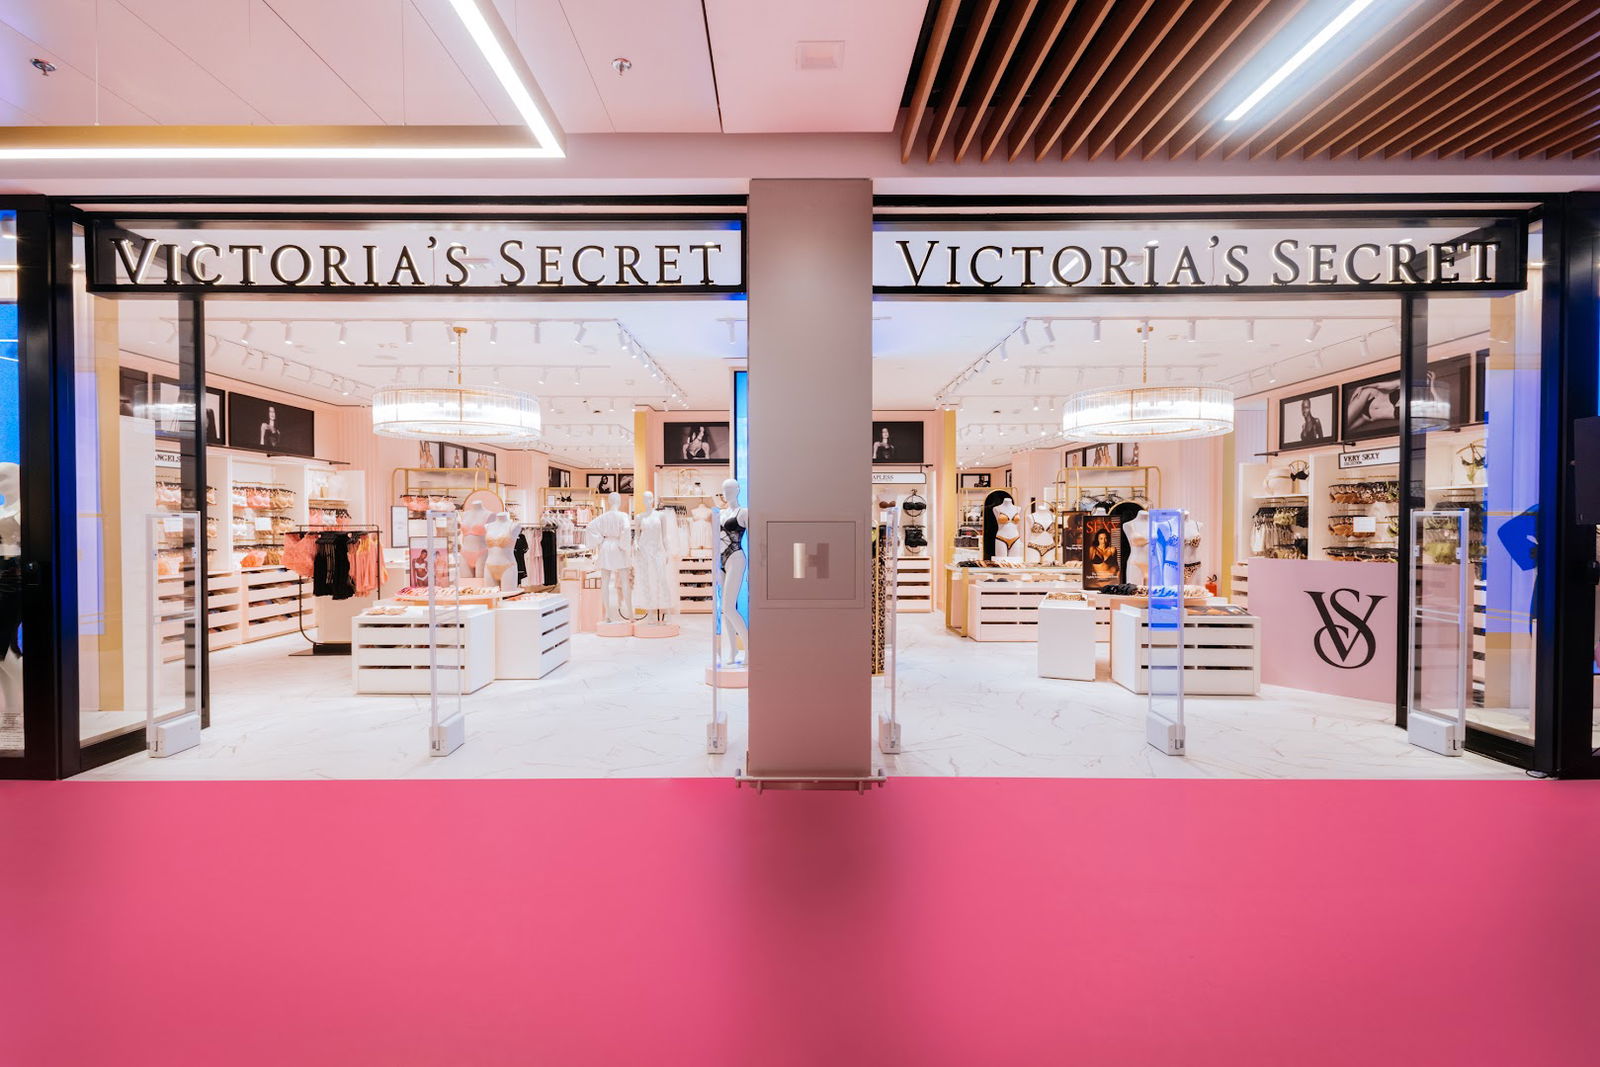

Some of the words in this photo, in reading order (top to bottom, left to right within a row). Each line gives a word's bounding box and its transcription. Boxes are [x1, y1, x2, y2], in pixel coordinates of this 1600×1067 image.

[109, 236, 469, 285] VICTORIA'S
[499, 239, 722, 285] SECRET
[895, 235, 1250, 286] VICTORIA'S
[1271, 239, 1501, 285] SECRET
[1086, 519, 1120, 535] SEXY
